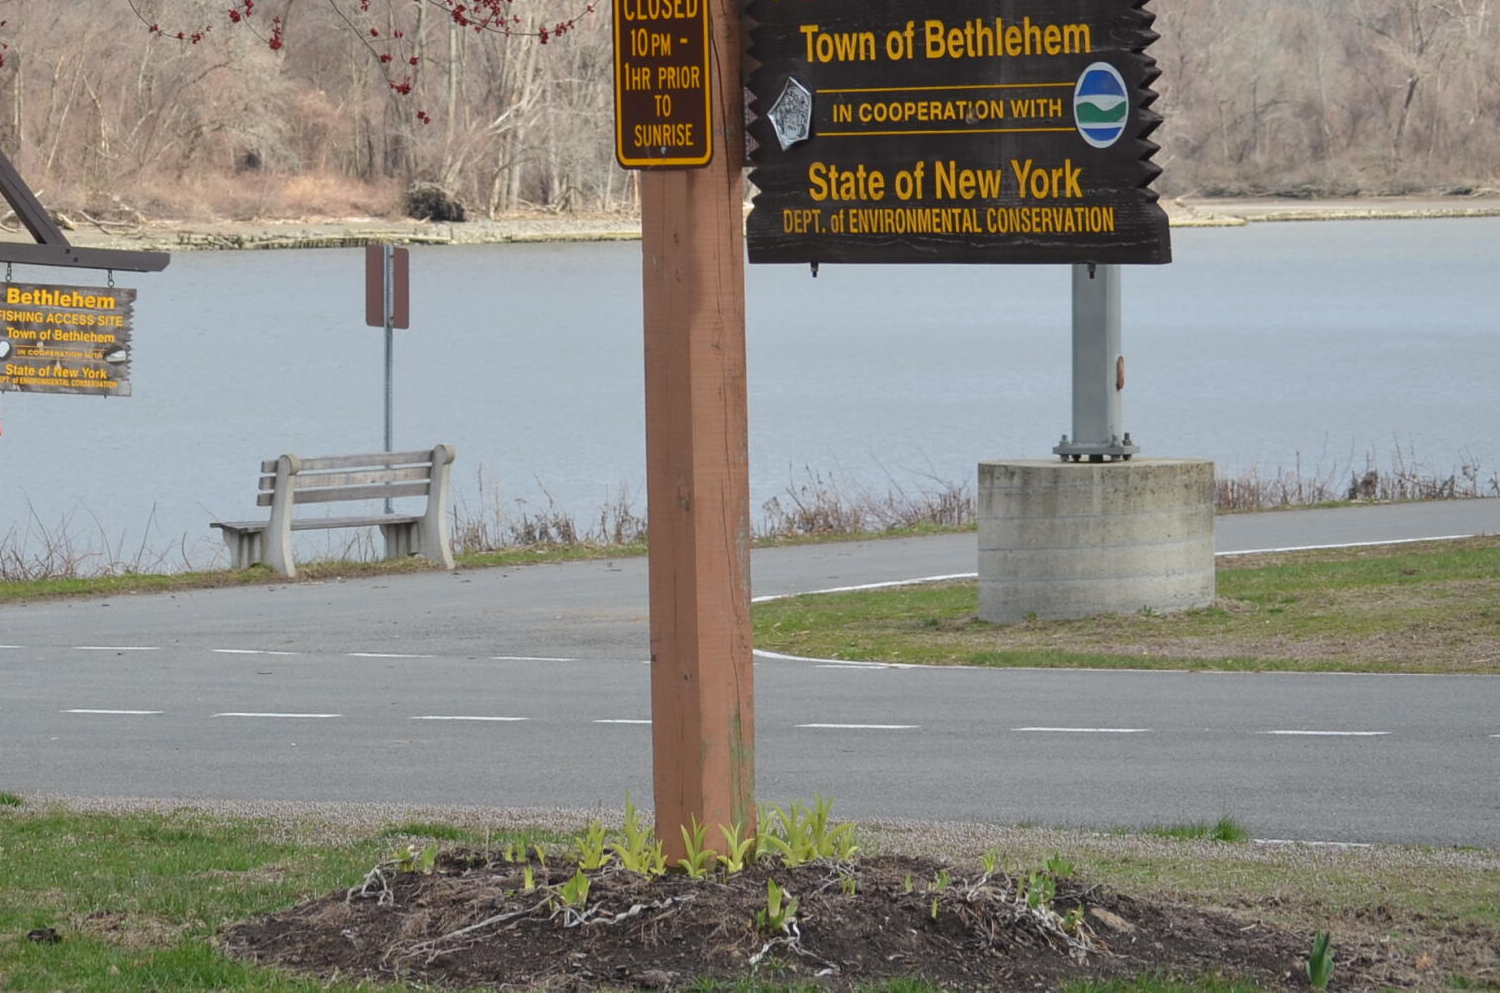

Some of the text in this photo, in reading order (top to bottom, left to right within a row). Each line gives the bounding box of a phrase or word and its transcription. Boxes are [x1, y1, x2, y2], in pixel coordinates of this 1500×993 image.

[800, 16, 1091, 63] Town of Bethlehem
[658, 65, 700, 89] PRIOR
[654, 94, 671, 117] TO
[833, 98, 1062, 123] IN COOPERATION WITH
[634, 123, 694, 148] SUNRISE
[808, 158, 1084, 202] State of New York
[783, 206, 1114, 234] DEPT. of ENVIRONMENTAL CONSERVATION
[6, 287, 116, 309] Bethlehem
[46, 313, 94, 326] ACCESS
[97, 315, 123, 327] SITE
[6, 327, 116, 343] Town of Bethlehem
[5, 364, 108, 380] State of New York
